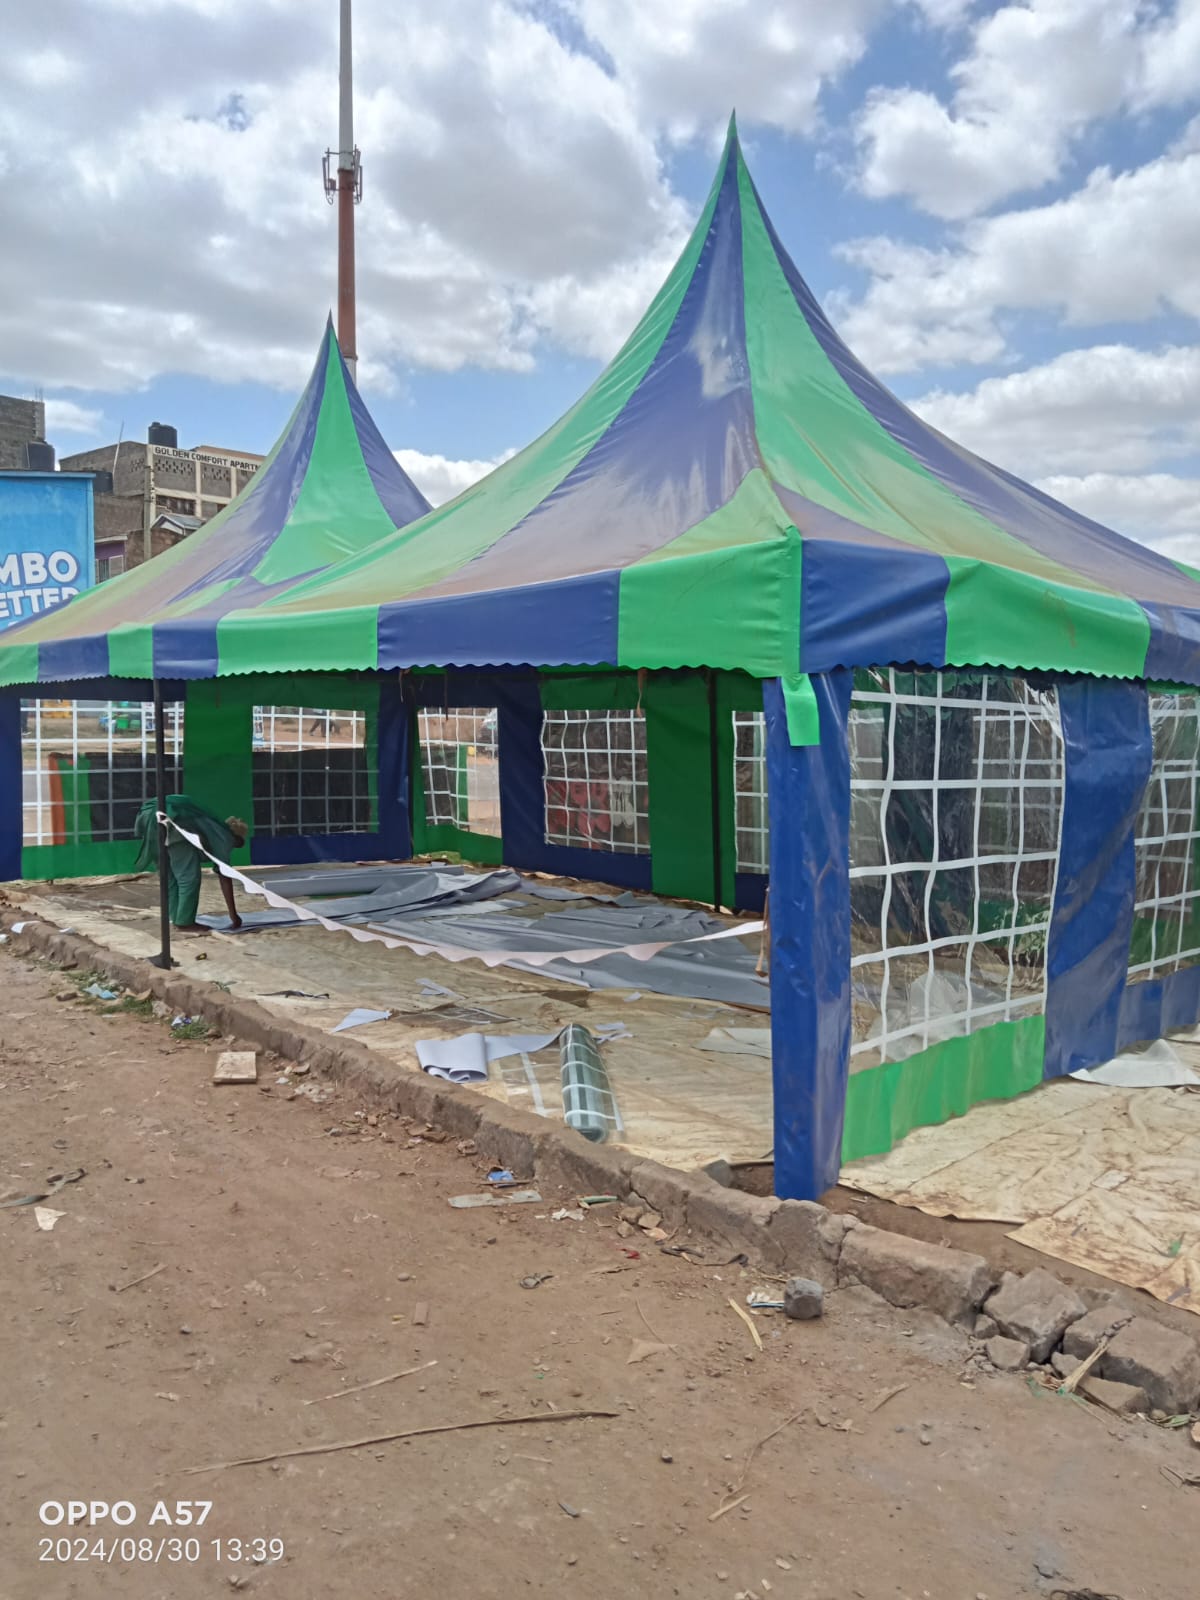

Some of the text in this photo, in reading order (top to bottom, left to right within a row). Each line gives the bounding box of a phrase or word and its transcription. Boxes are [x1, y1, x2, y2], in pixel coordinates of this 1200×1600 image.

[155, 447, 189, 459] GOLDEN
[191, 451, 229, 465] COMFORT
[0, 551, 77, 586] MBO
